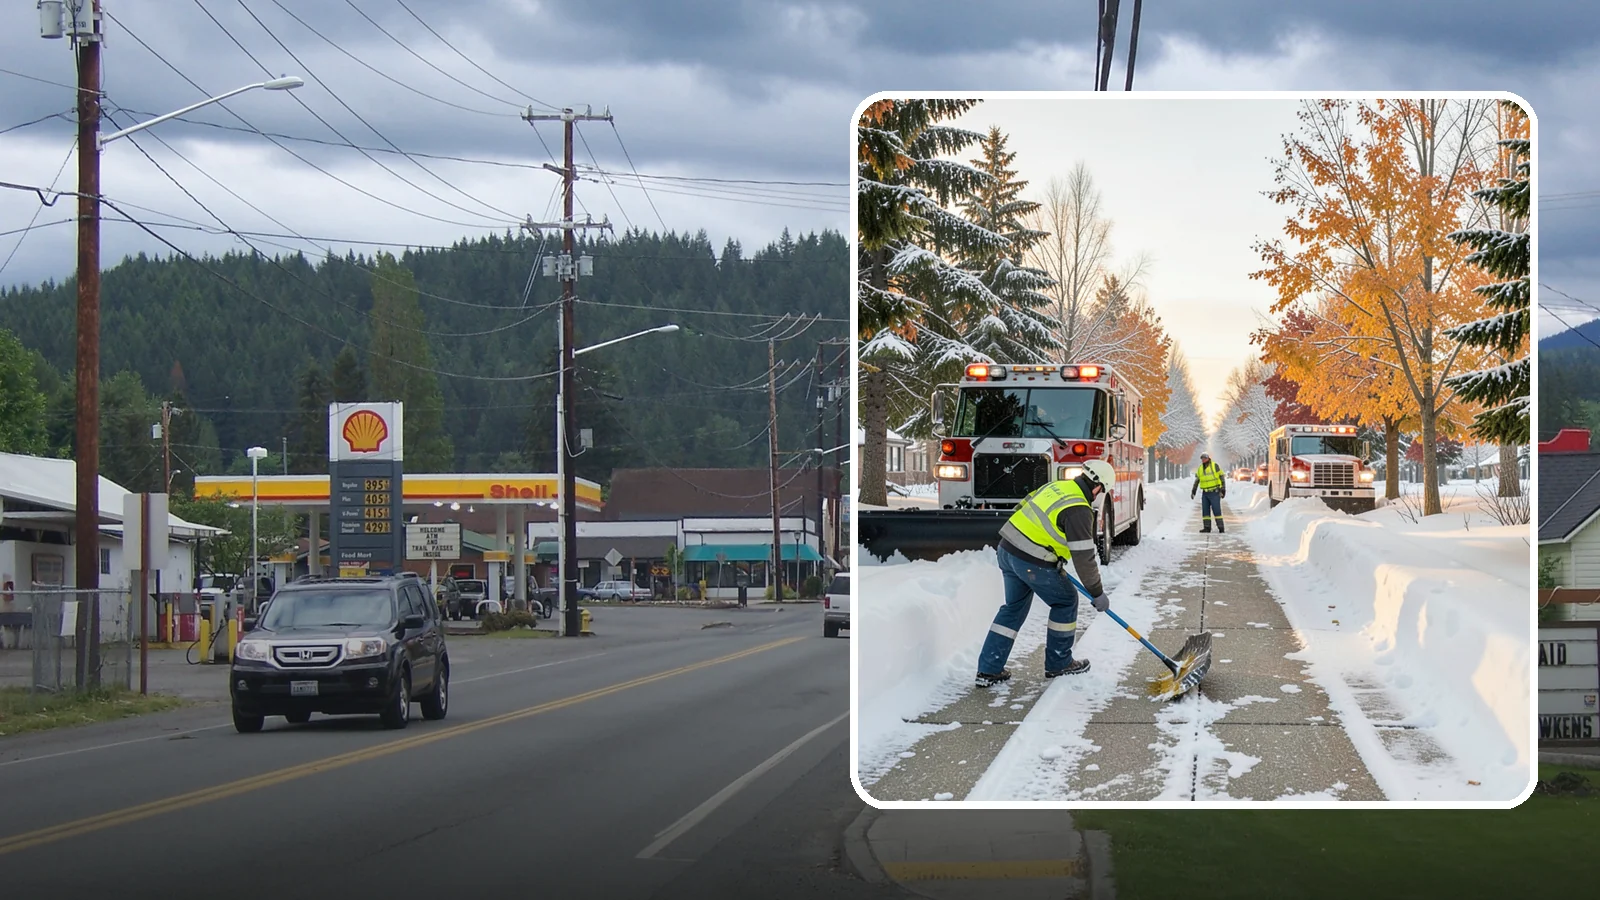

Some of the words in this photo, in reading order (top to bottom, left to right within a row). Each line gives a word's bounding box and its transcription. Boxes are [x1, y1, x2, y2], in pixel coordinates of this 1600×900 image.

[366, 480, 383, 490] 395
[490, 484, 547, 499] Shell
[366, 494, 383, 504] 405
[366, 508, 383, 518] 415
[366, 522, 383, 532] 429
[1538, 642, 1567, 666] AID
